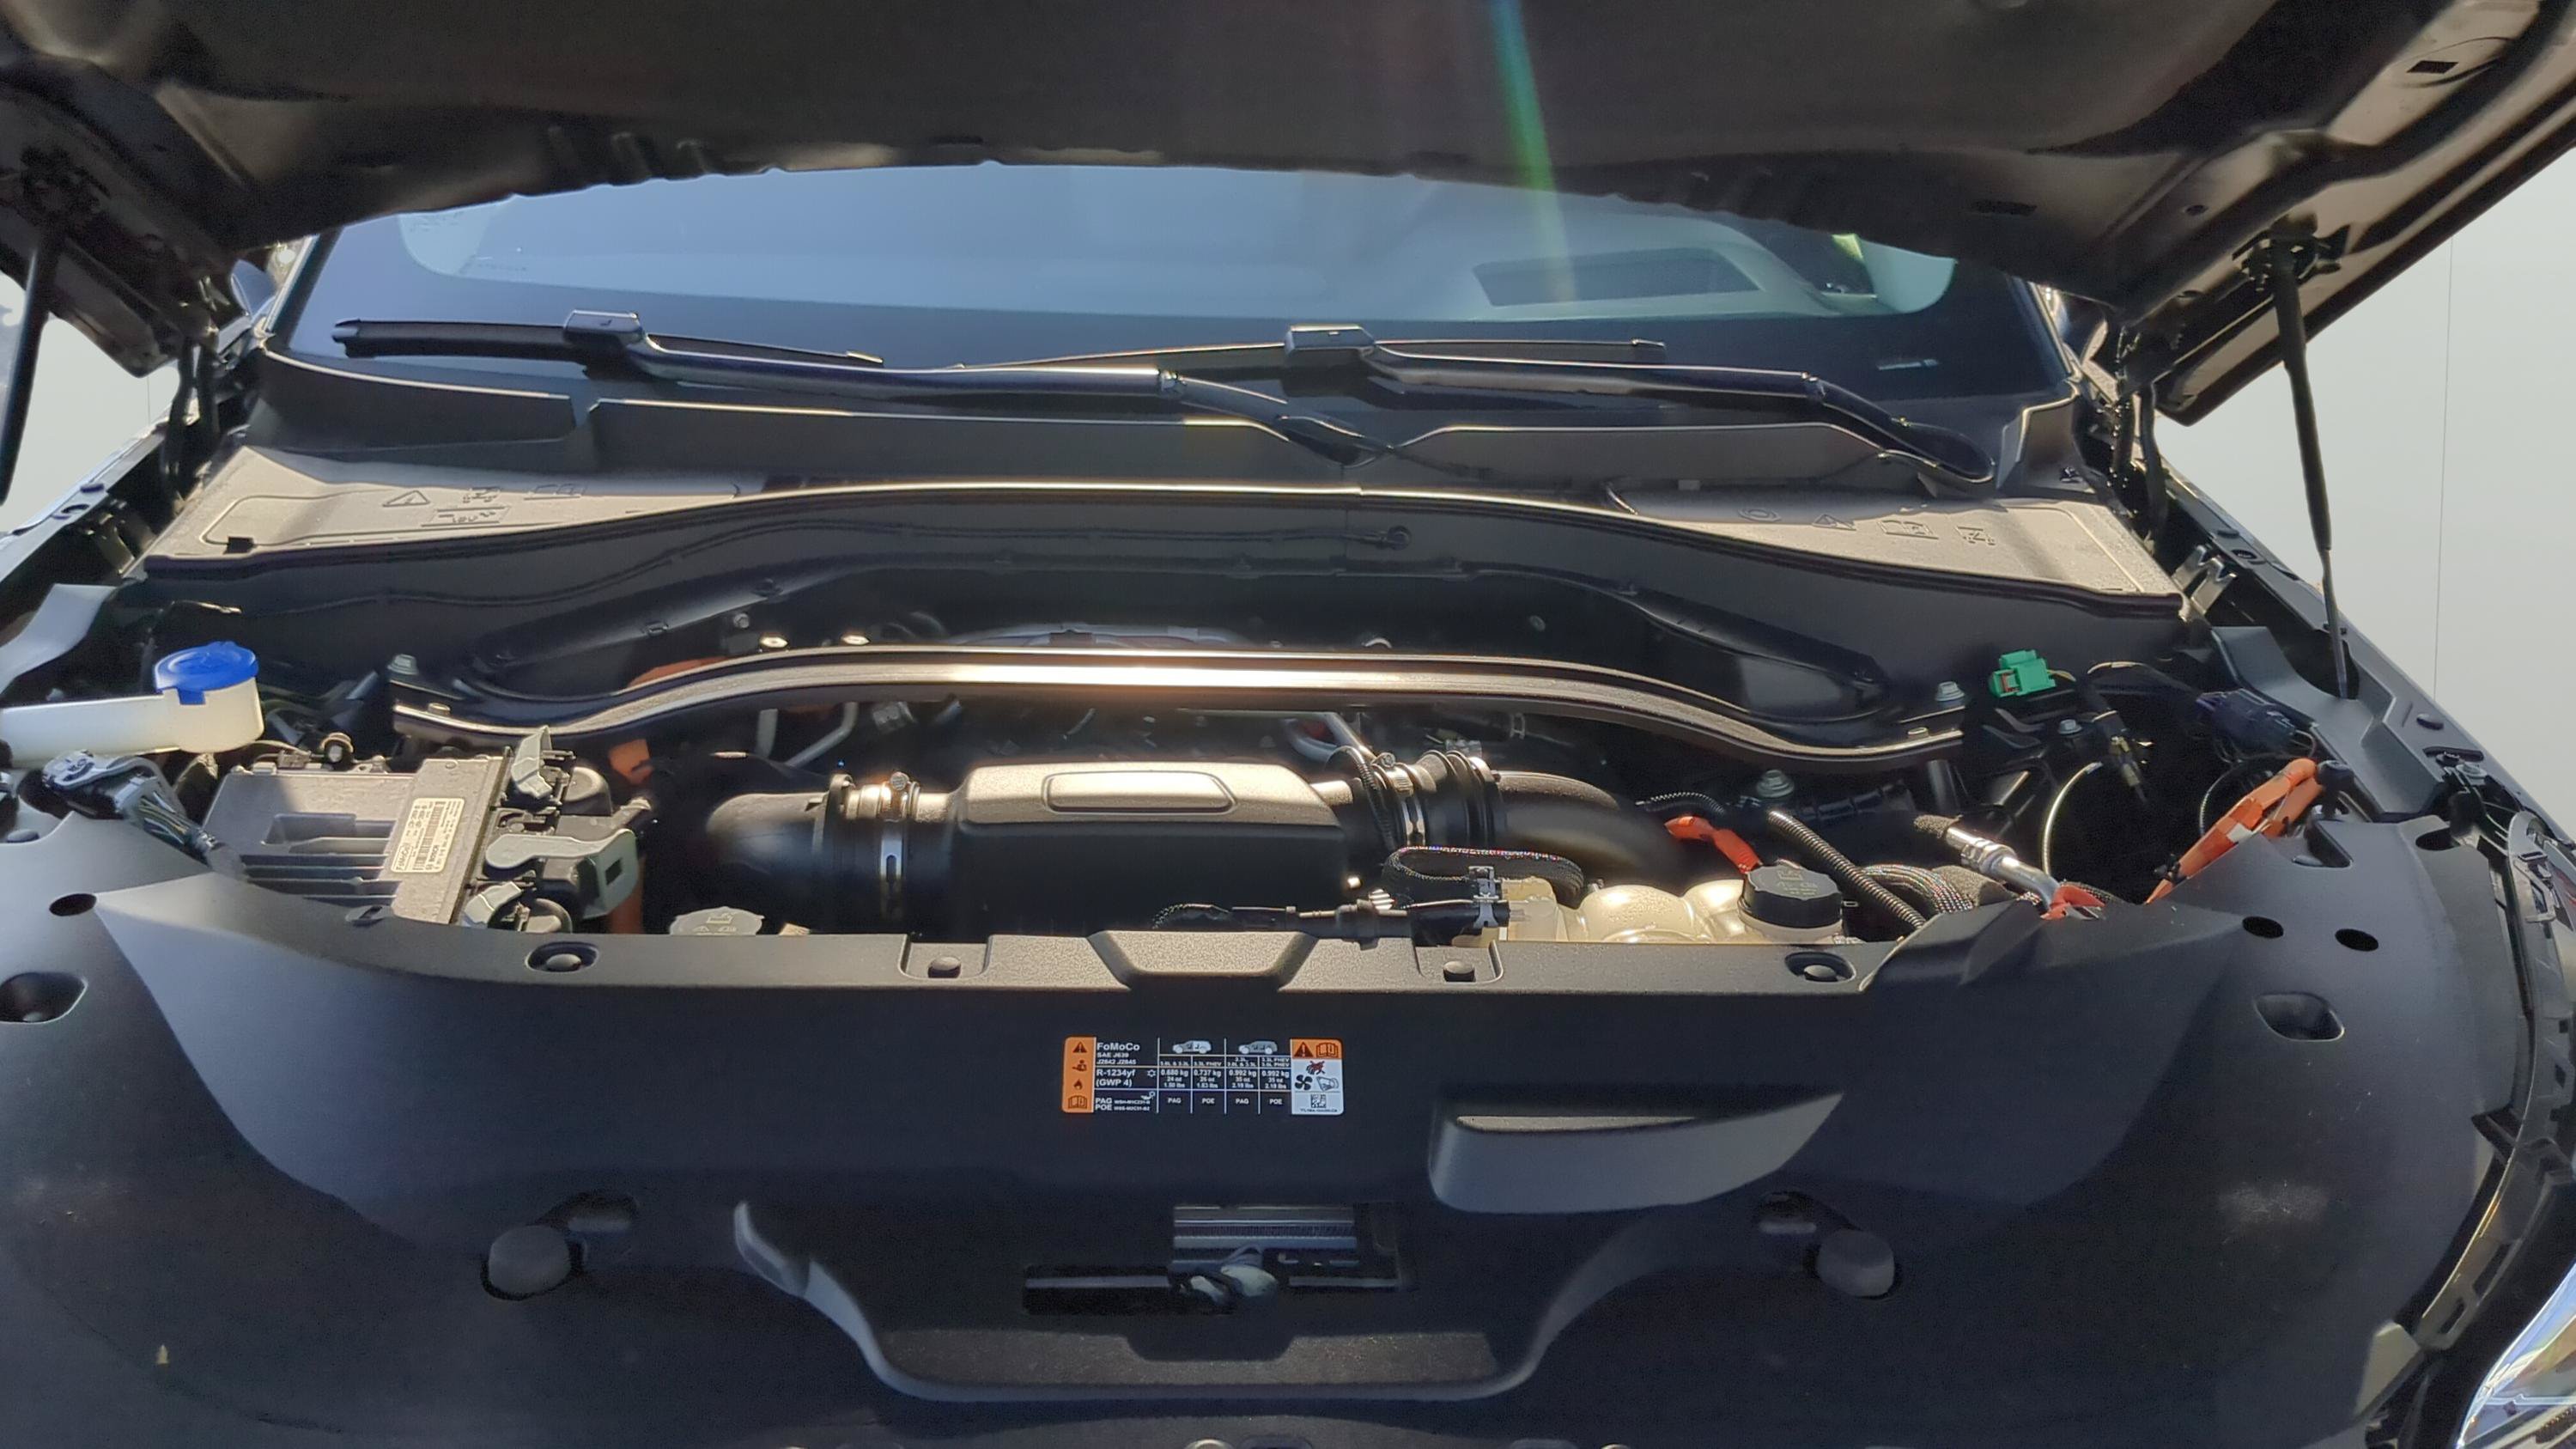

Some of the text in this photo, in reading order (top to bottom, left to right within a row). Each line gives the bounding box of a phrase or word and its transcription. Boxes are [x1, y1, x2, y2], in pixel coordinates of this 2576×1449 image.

[1097, 1042, 1140, 1051] FoMoCo
[1096, 1069, 1136, 1078] R-1234yf
[1096, 1079, 1122, 1087] (GWP
